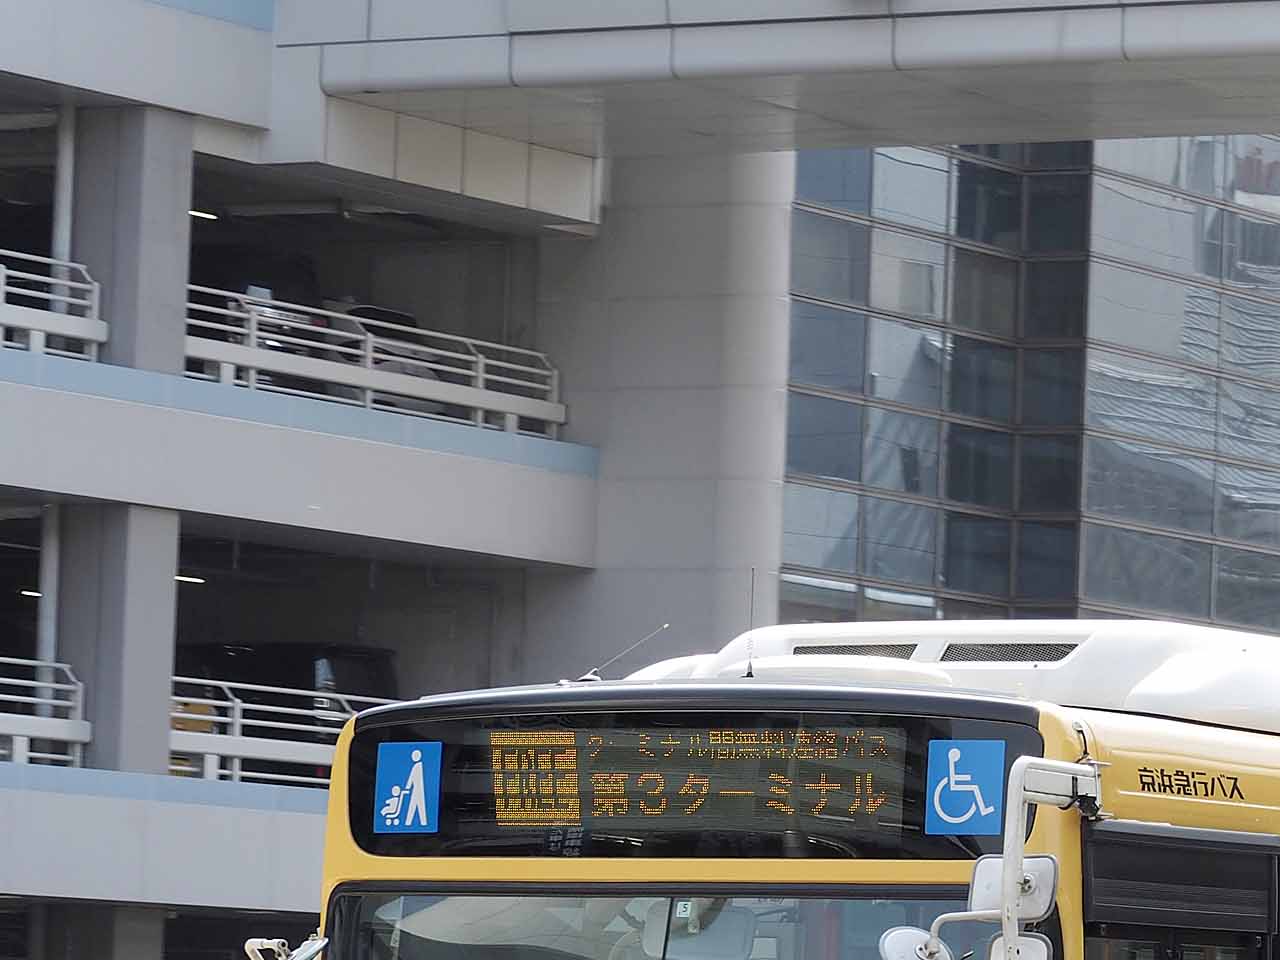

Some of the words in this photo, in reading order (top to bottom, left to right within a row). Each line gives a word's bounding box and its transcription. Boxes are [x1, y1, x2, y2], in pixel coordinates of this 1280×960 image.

[590, 772, 887, 817] 第3ターミナル
[1138, 767, 1245, 800] 京浜急行バス
